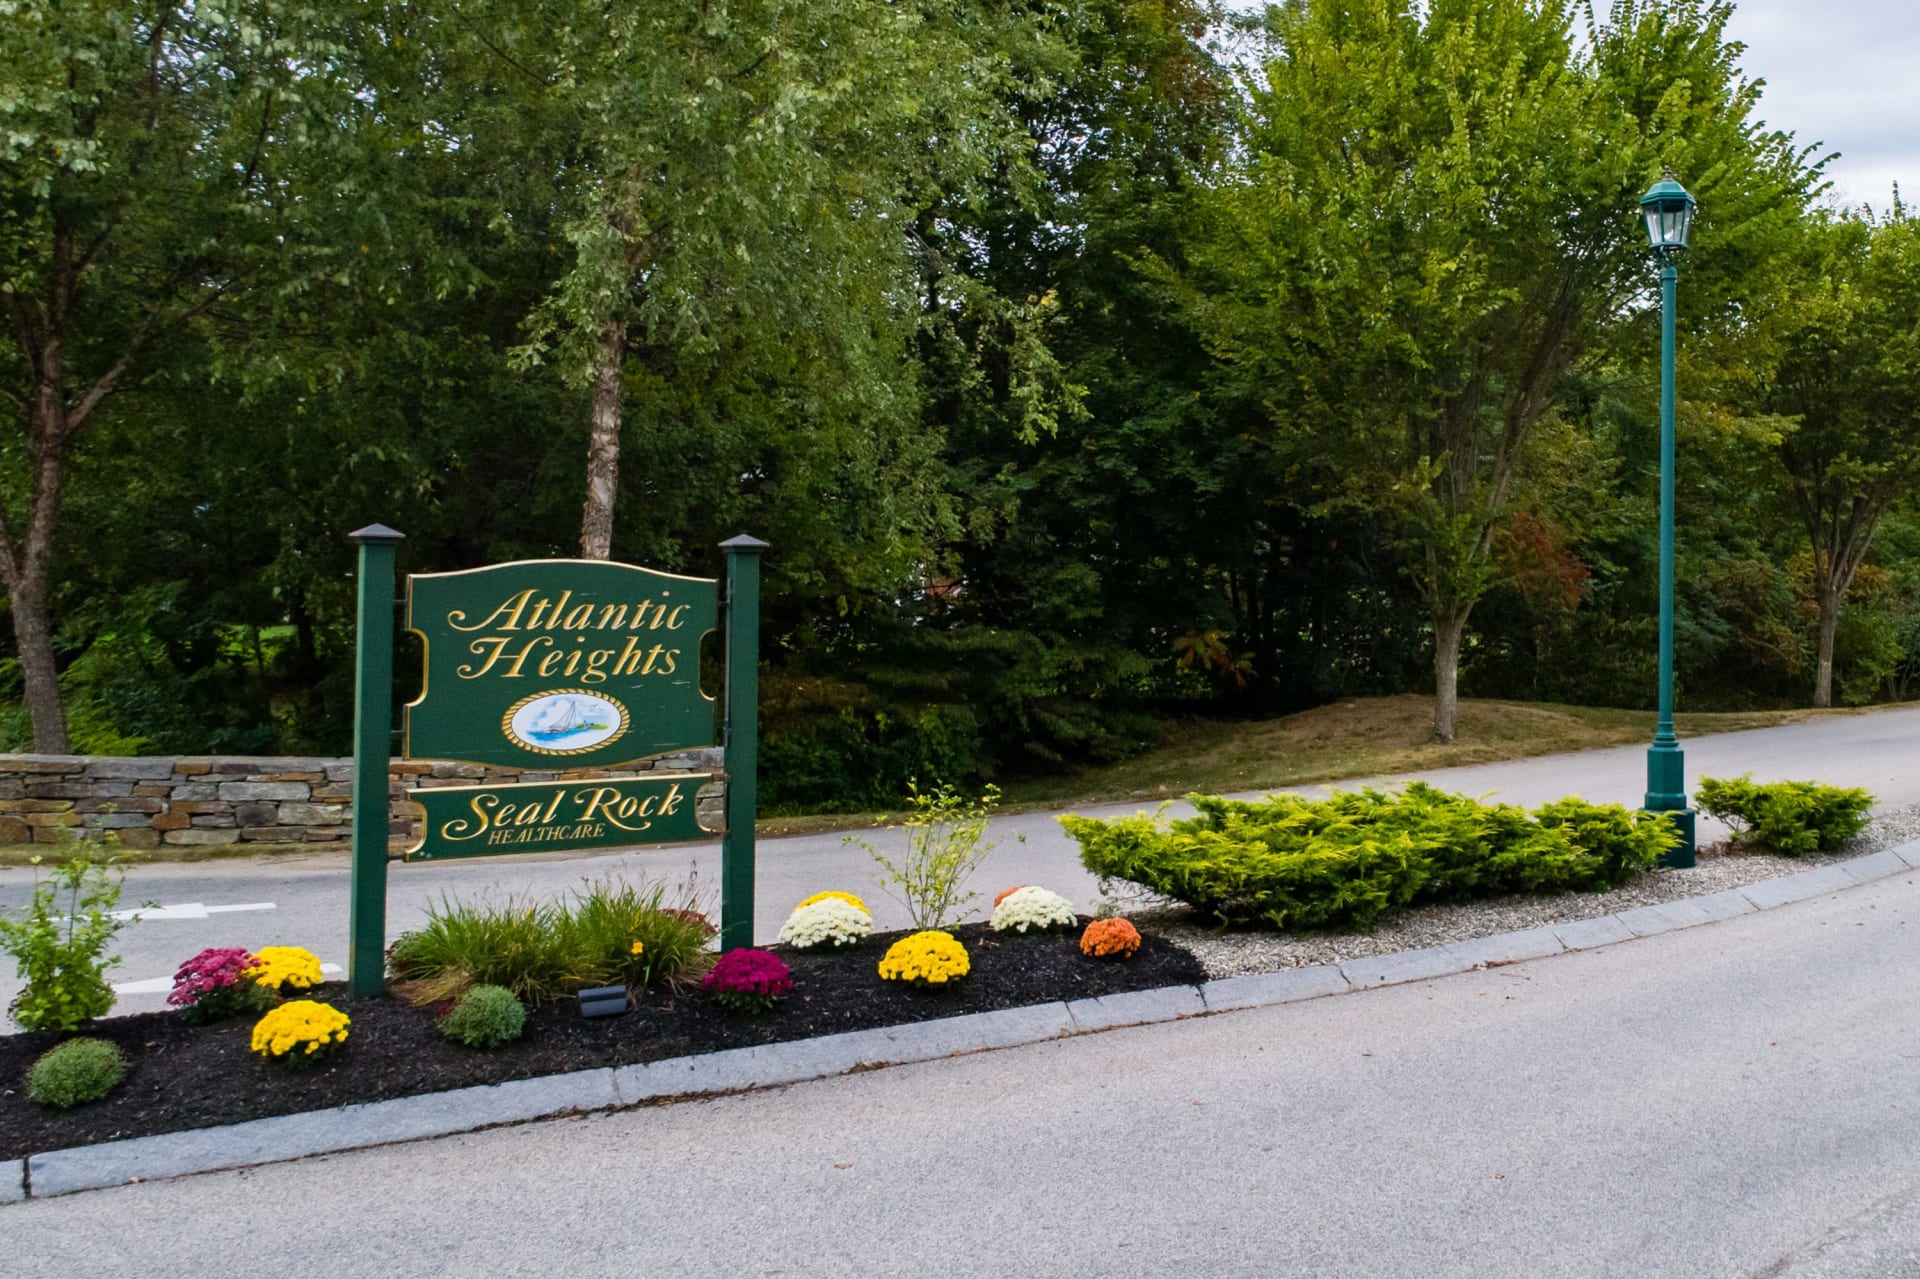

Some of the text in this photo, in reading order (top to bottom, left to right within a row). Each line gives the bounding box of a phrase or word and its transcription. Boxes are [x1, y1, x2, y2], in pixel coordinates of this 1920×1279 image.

[448, 589, 690, 631] Atlantic
[456, 635, 681, 684] Heights
[442, 783, 684, 841] Seal Rock
[488, 822, 606, 845] HEALTHCARE
